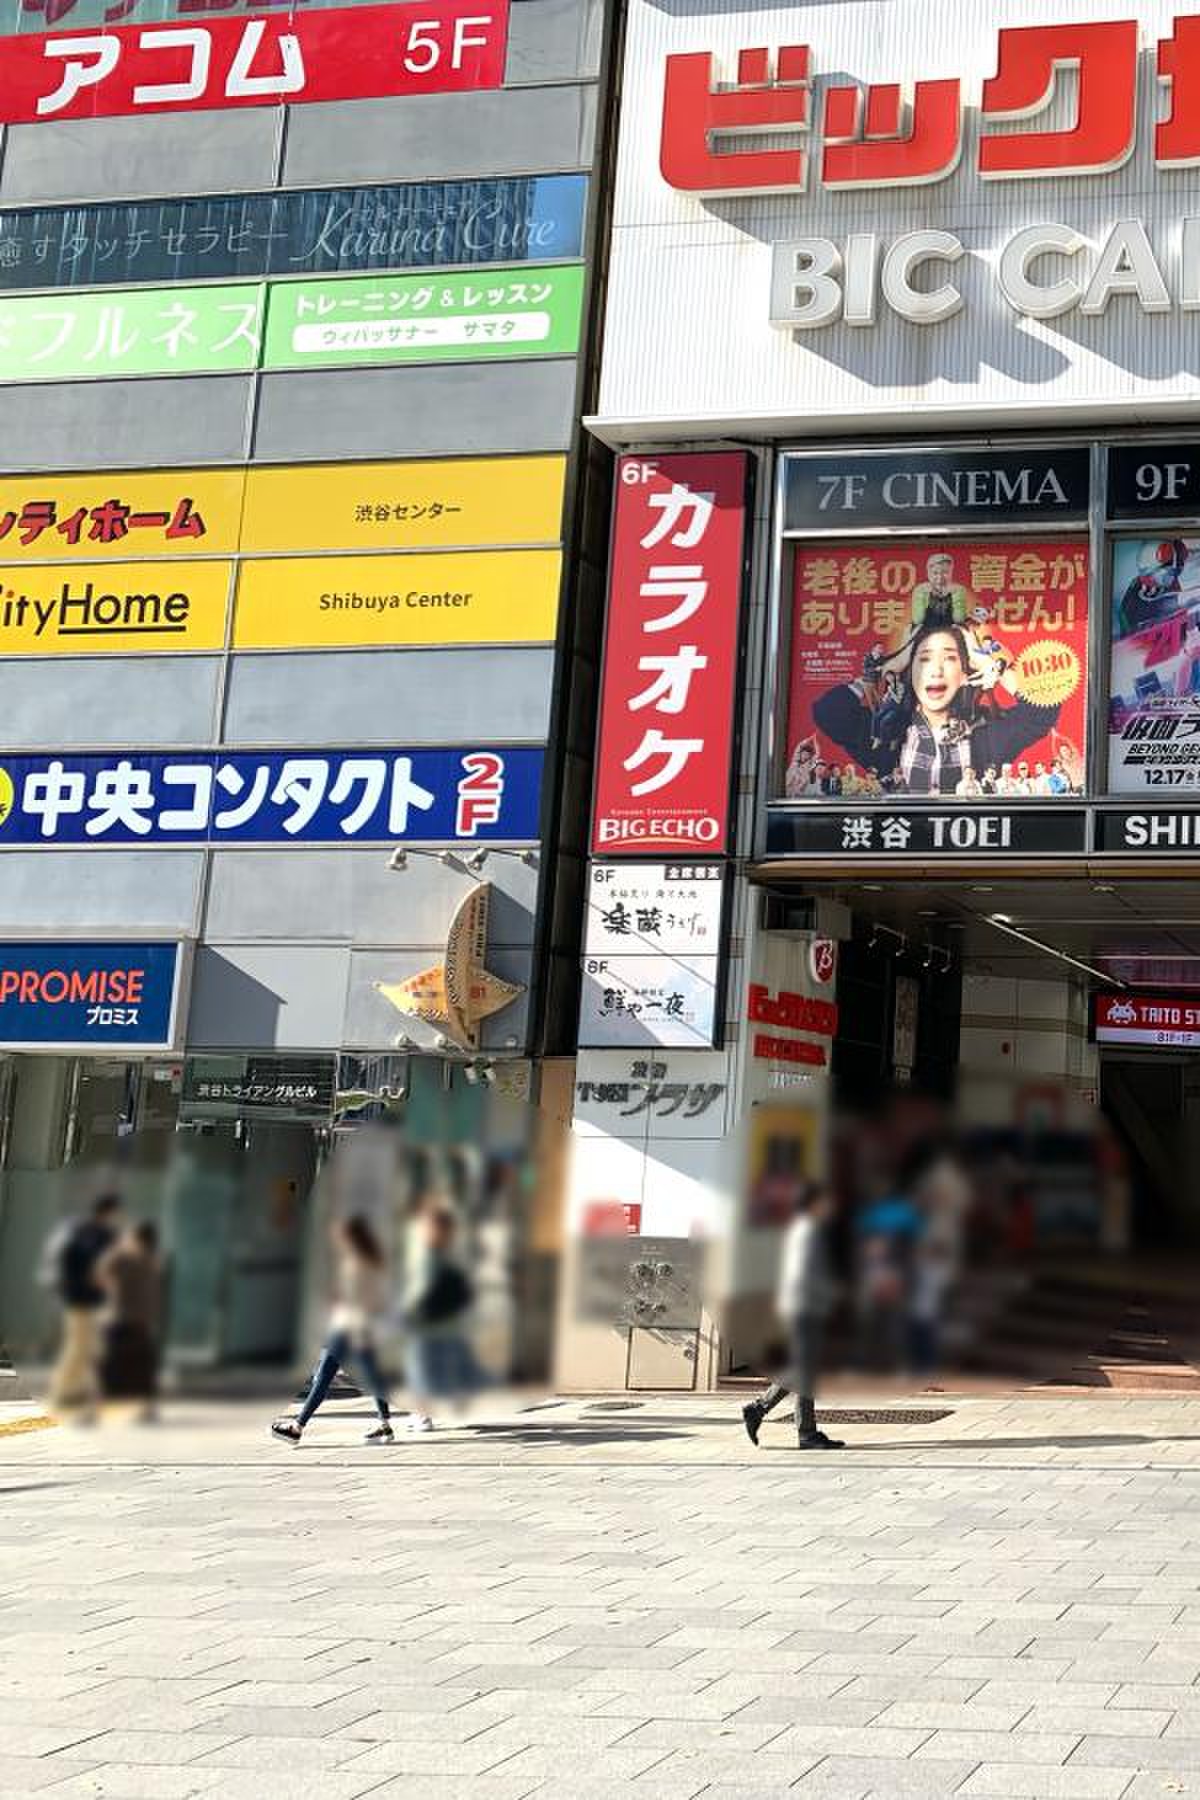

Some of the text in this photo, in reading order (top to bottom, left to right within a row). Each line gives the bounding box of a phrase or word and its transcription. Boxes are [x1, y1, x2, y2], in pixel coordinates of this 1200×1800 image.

[36, 16, 492, 115] アコム 5F
[768, 230, 965, 330] BIC
[621, 462, 660, 486] 6F
[816, 467, 1068, 511] 7F CINEMA
[1135, 464, 1191, 500] 9F
[355, 503, 462, 522] 渋谷センター
[802, 553, 1086, 596] 老後の 資金が
[0, 583, 191, 636] ityHome
[319, 591, 474, 613] Shibuya Center
[801, 600, 906, 637] ありま
[622, 483, 717, 798] カラオケ
[22, 757, 435, 836] 中央コンタクト
[456, 752, 505, 836] 2F
[598, 817, 720, 844] BIG ECHO
[842, 817, 1010, 848] 渋谷 TOEI
[594, 869, 615, 883] 6F
[587, 960, 608, 974] 6F
[0, 969, 145, 1003] PROMISE
[86, 1005, 139, 1025] プロミス
